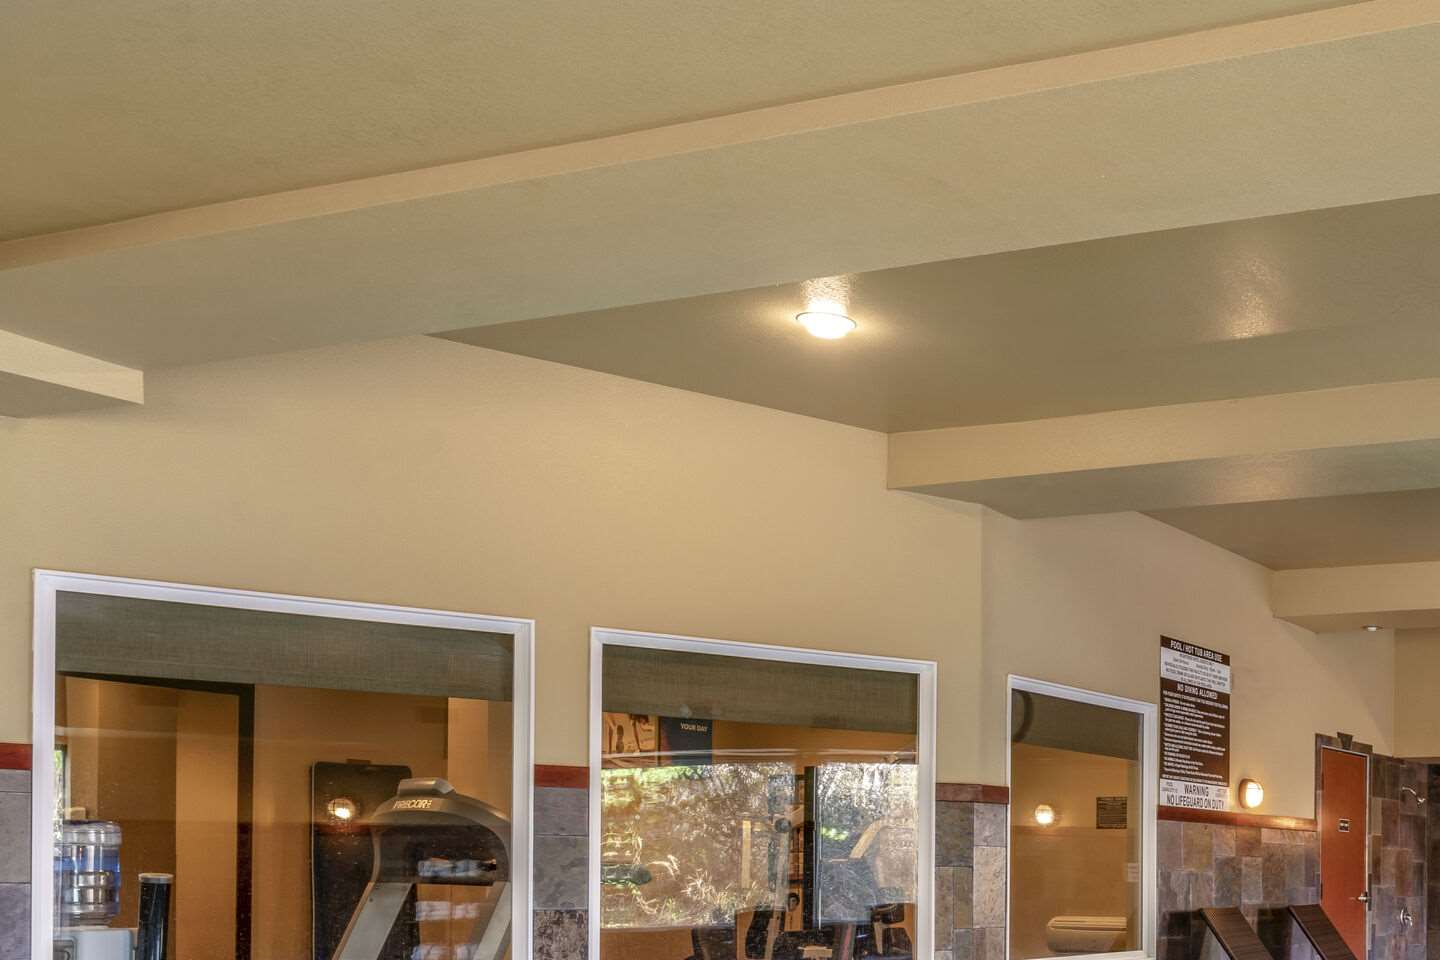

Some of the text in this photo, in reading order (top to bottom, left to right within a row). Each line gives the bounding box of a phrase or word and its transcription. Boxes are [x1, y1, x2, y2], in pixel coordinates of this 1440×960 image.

[1170, 640, 1182, 651] POOL
[1184, 685, 1199, 696] DIVING
[1199, 688, 1217, 700] ALLOWED
[680, 722, 708, 732] YOUR DAY
[1184, 783, 1209, 797] WARNING
[1166, 794, 1225, 810] NO LIFEGUARD ON DUTY
